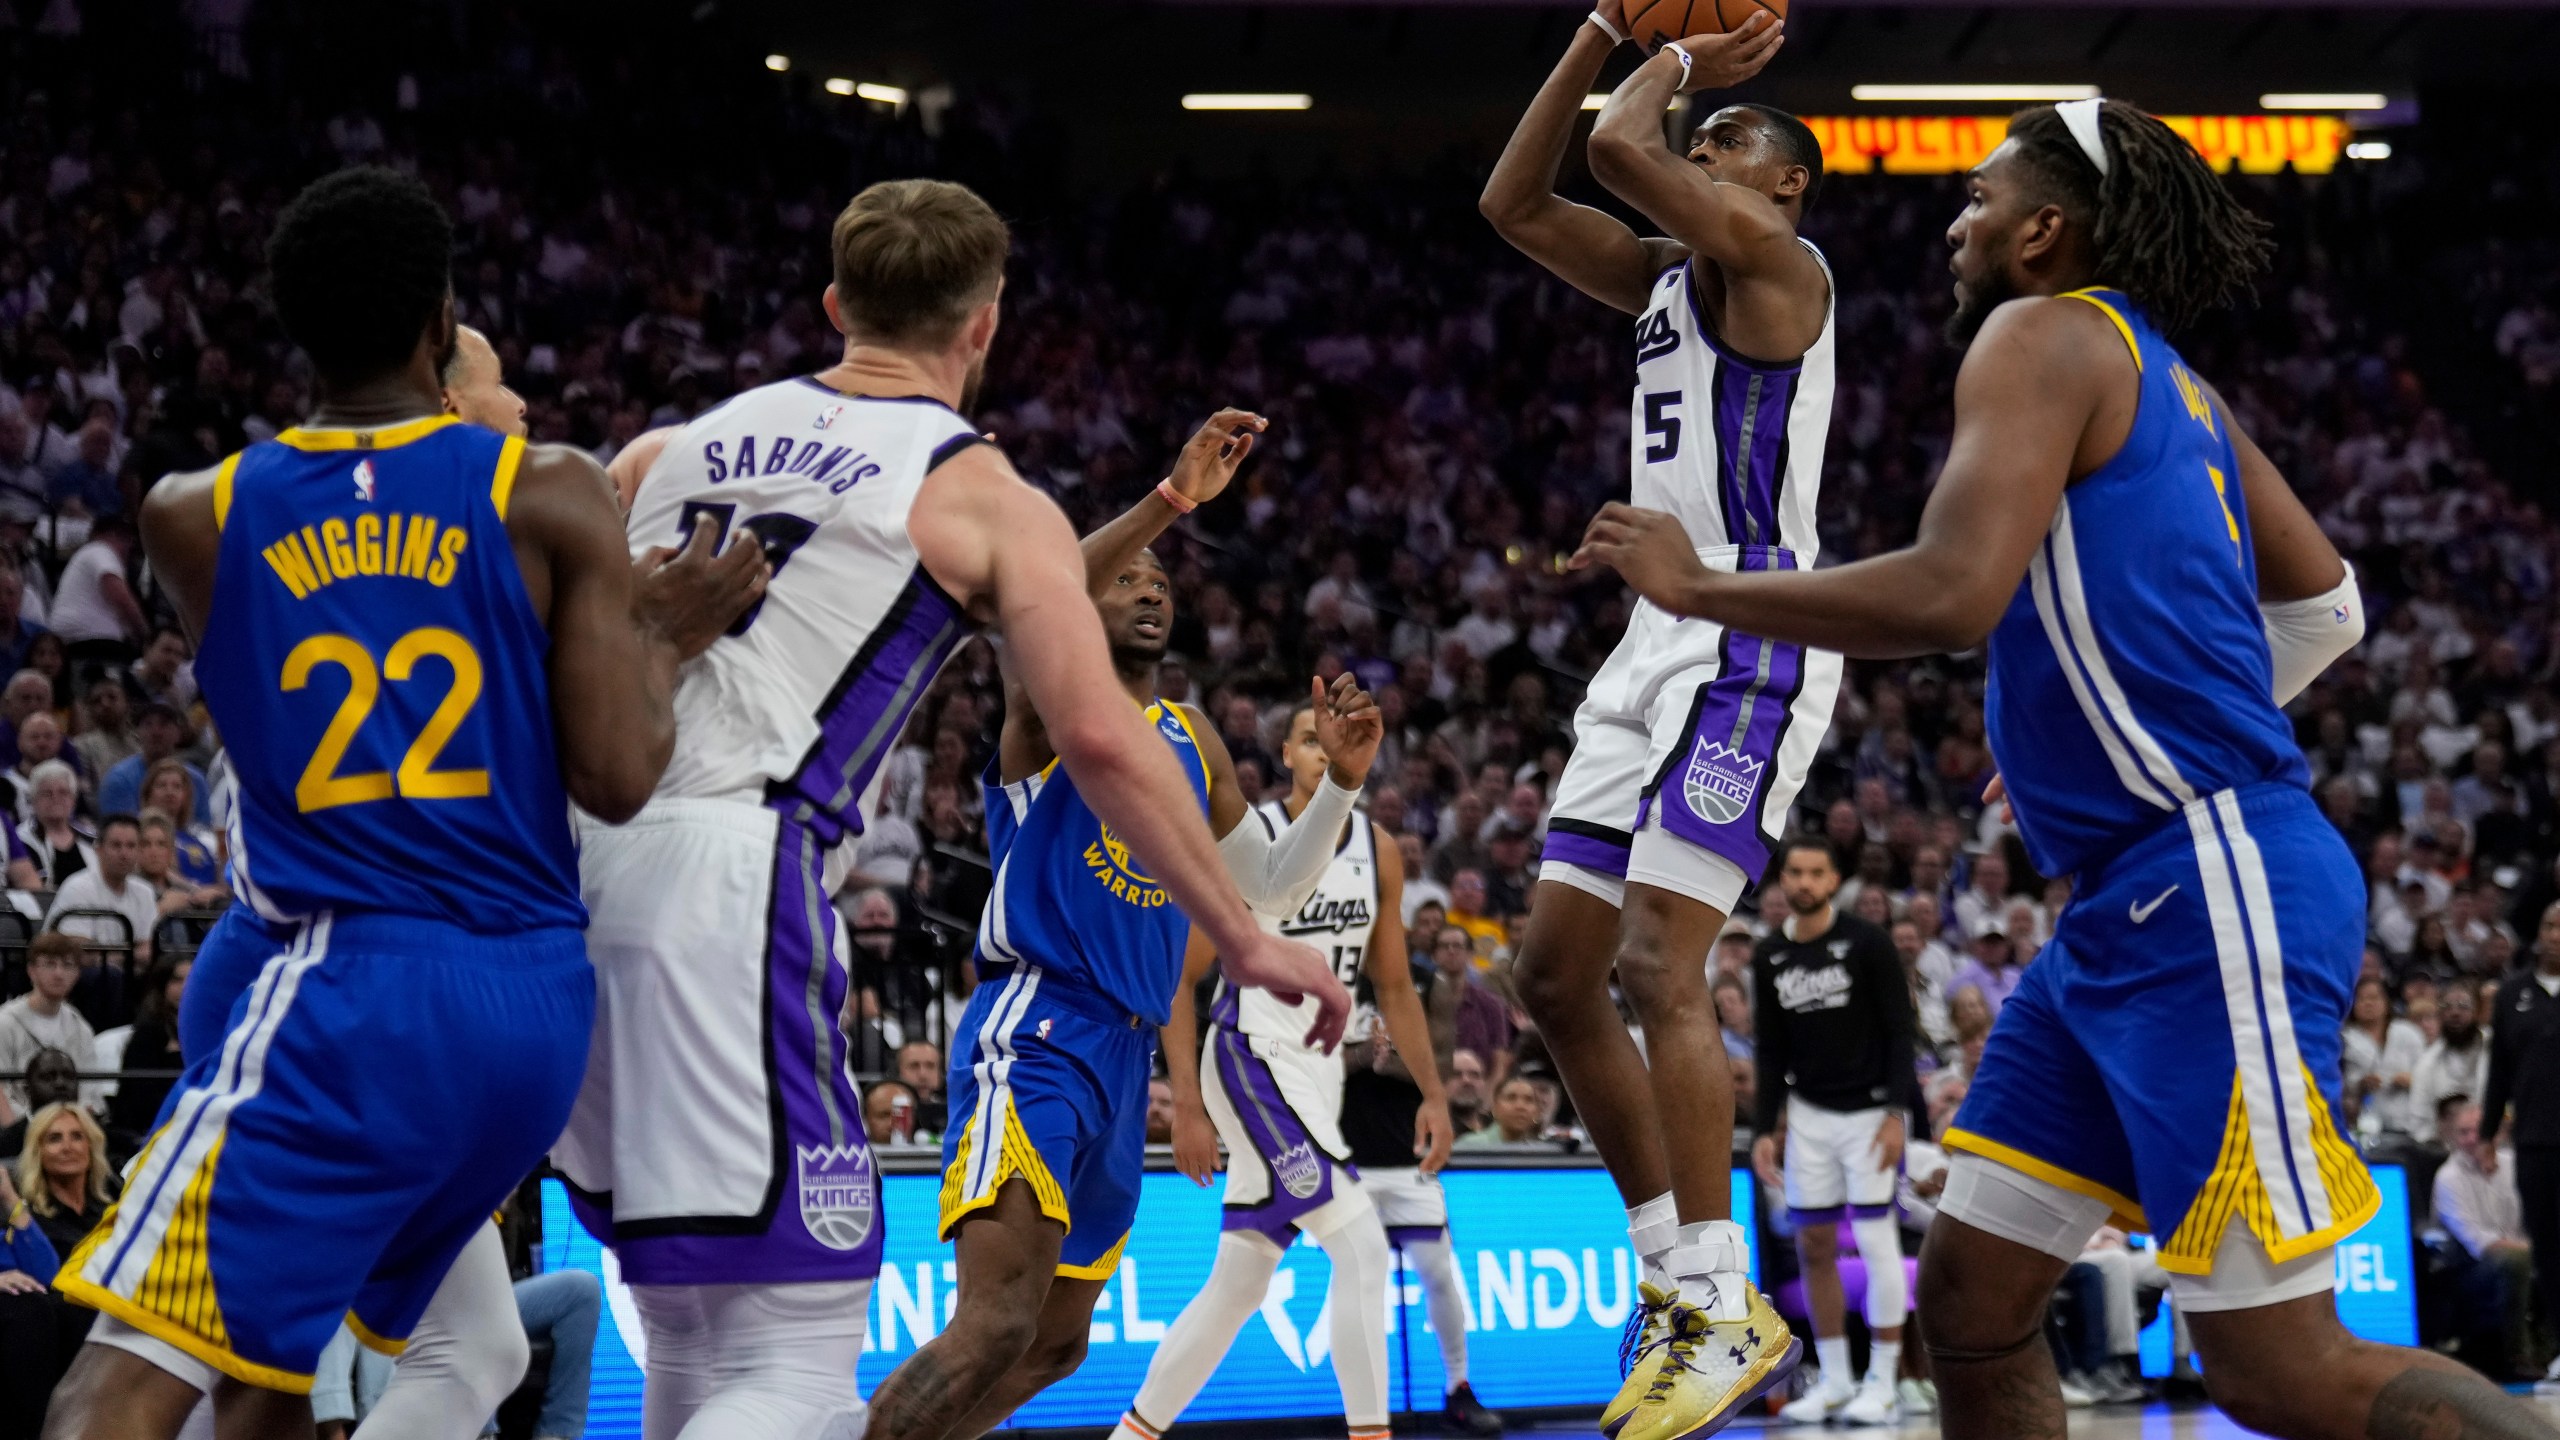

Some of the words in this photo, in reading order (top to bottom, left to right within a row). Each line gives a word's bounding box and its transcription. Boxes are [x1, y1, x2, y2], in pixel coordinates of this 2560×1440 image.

[1644, 390, 1682, 464] 5
[703, 435, 881, 496] SABONIS
[261, 513, 468, 600] WIGGINS
[280, 626, 491, 814] 22
[1687, 767, 1750, 806] KINGS
[1695, 758, 1753, 788] SACRAMENTO
[1083, 841, 1172, 908] WARRIO
[1332, 945, 1362, 986] 13
[803, 1187, 871, 1208] KINGS
